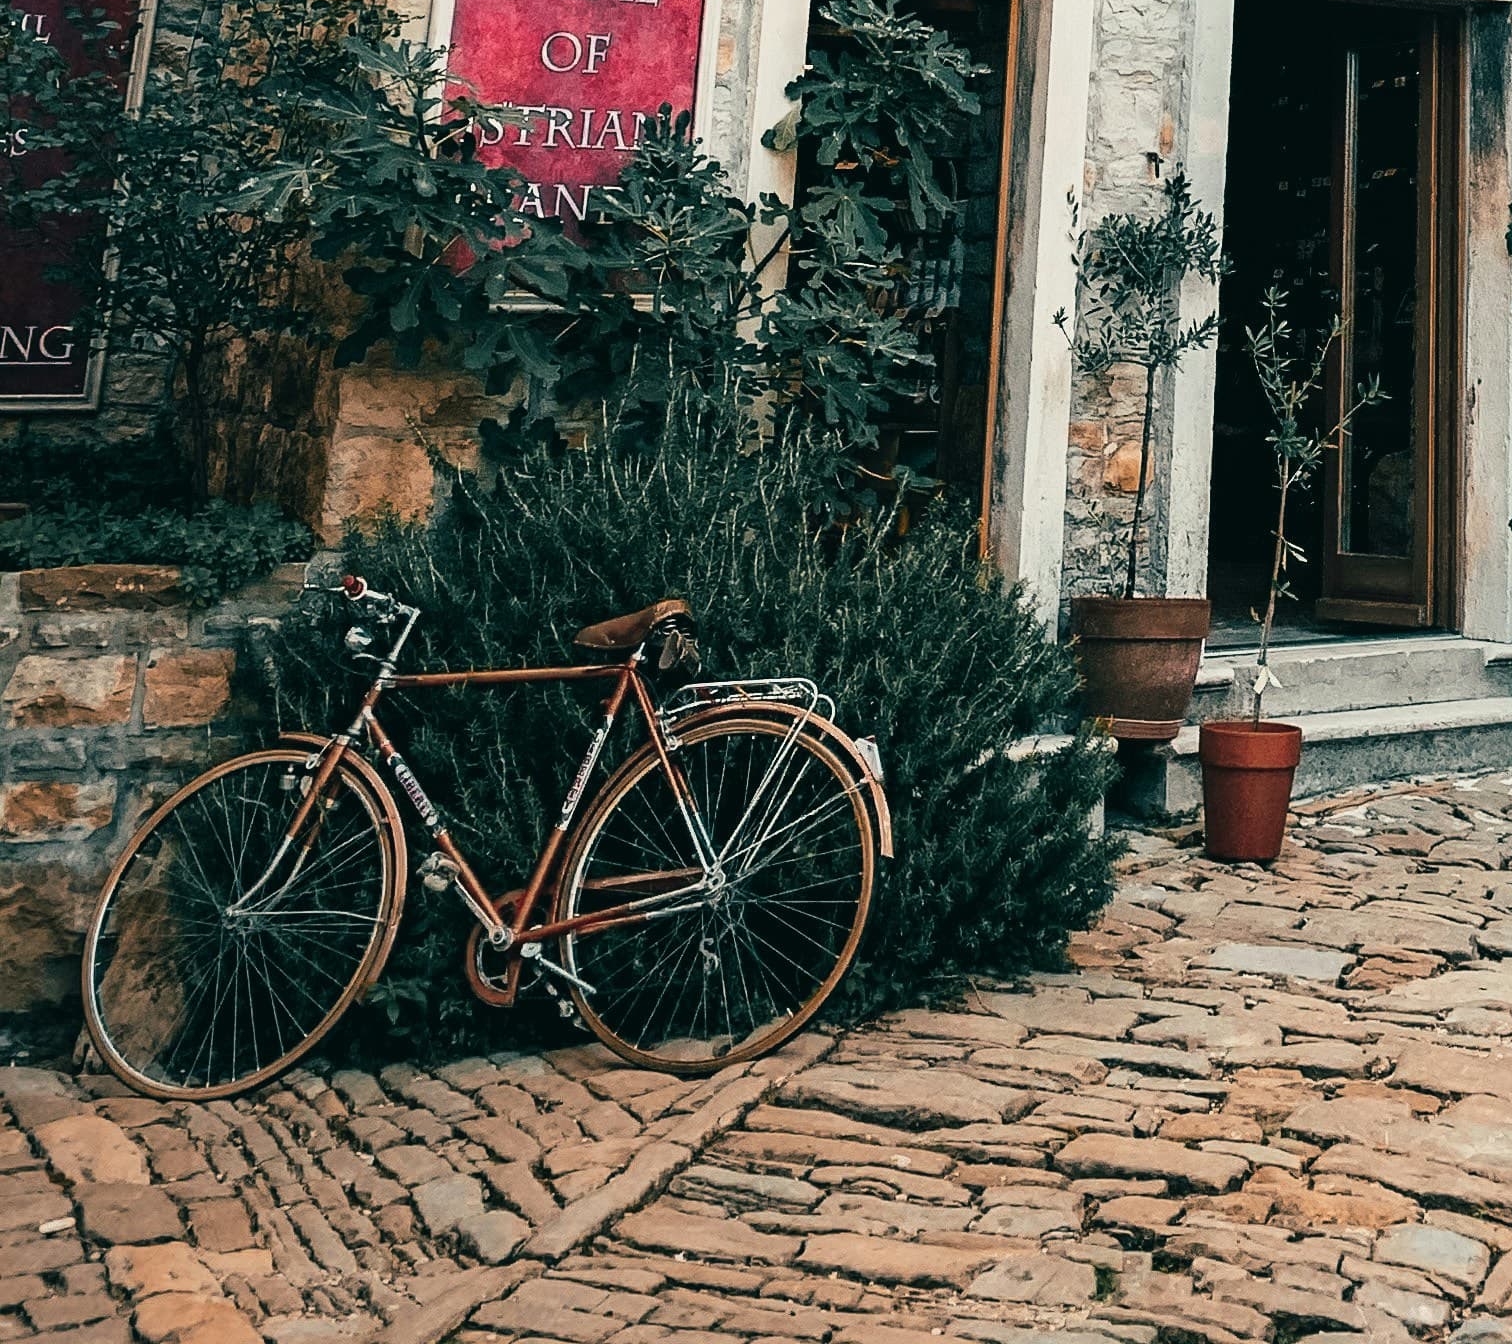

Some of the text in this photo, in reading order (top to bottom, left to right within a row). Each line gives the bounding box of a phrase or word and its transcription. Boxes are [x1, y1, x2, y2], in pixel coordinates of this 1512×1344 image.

[541, 31, 611, 74] OF
[466, 101, 664, 151] STRIA
[0, 325, 75, 361] NG
